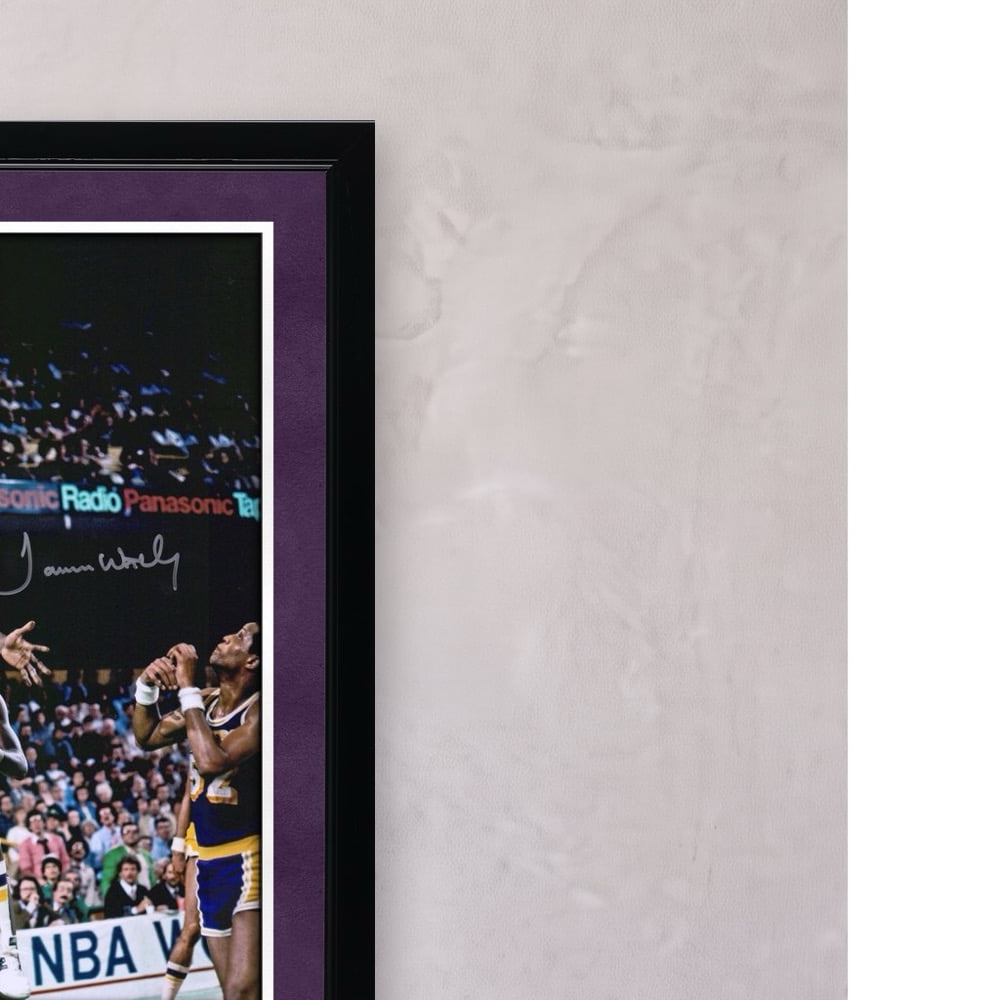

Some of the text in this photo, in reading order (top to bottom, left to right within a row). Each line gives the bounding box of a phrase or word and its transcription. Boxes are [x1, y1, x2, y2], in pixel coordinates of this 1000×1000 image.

[61, 484, 121, 513] Radio
[122, 488, 235, 516] Panasonic
[31, 925, 138, 987] NBA
